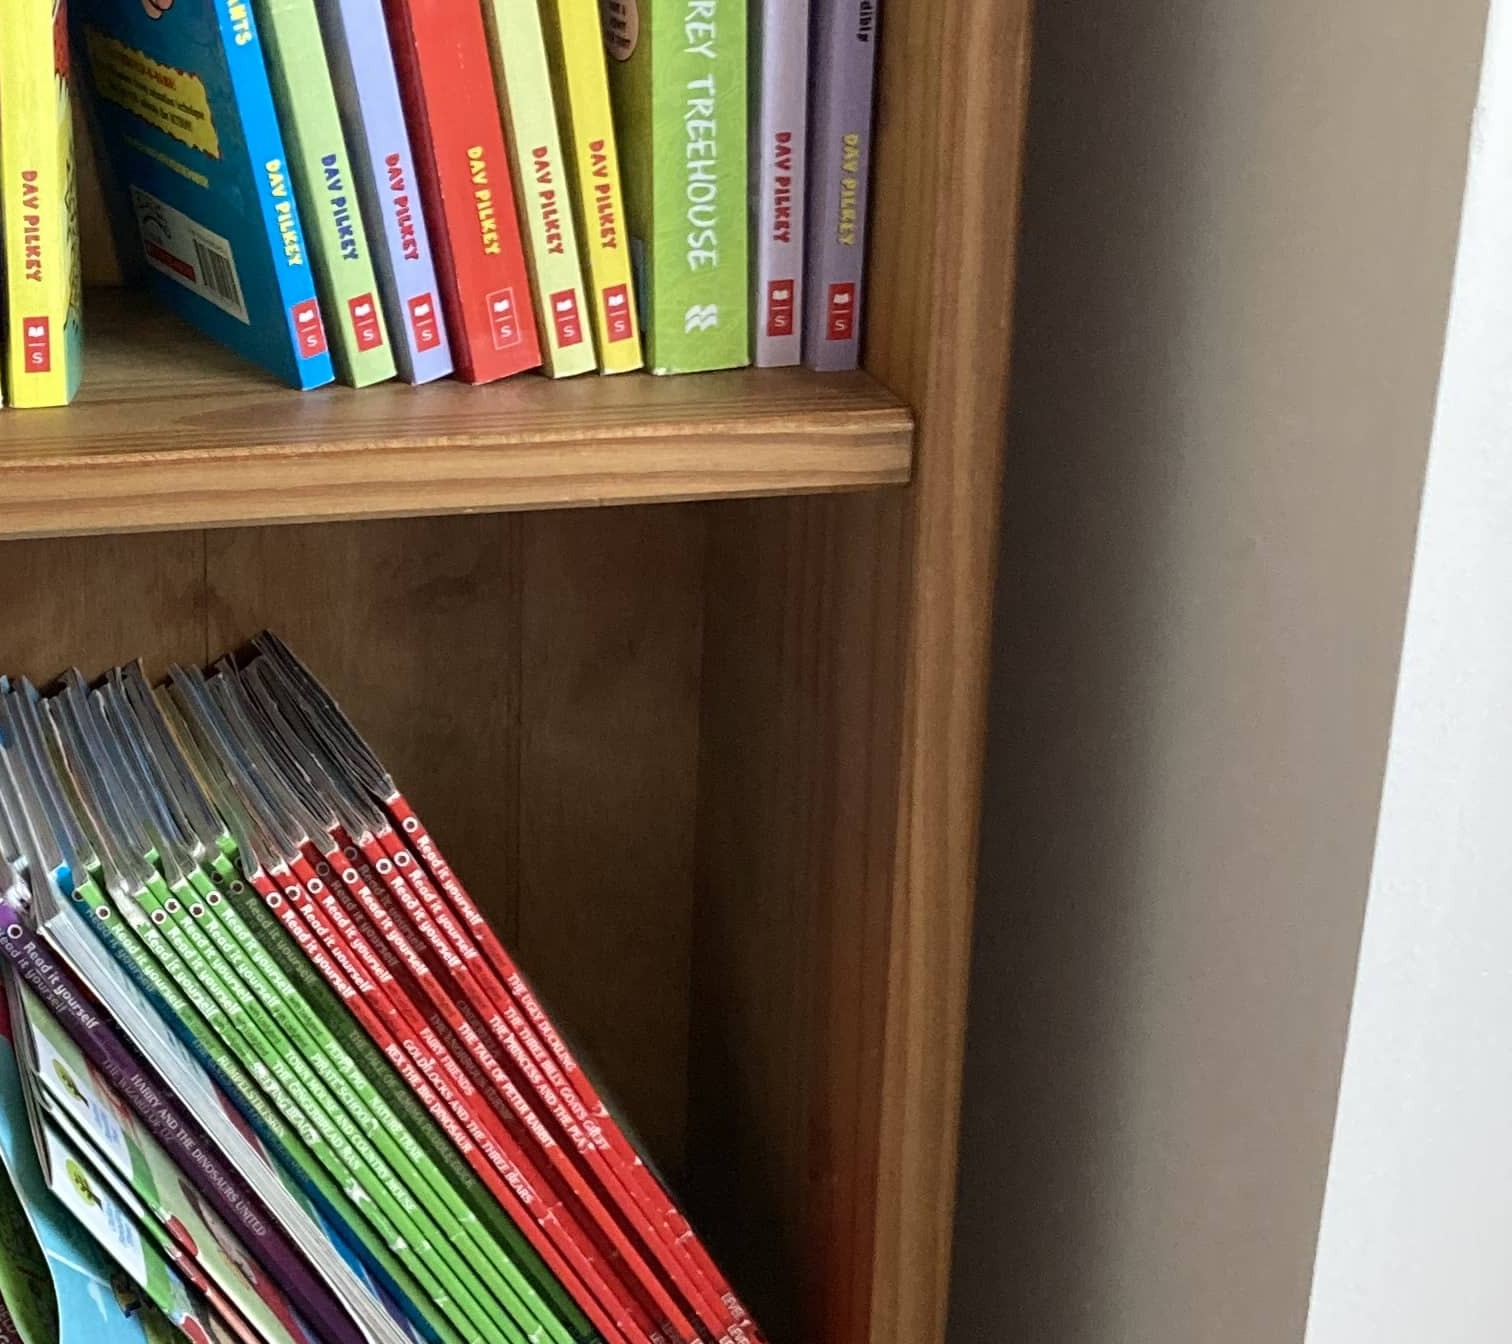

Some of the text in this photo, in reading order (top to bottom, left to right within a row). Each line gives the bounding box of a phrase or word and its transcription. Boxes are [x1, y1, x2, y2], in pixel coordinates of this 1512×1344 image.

[22, 170, 43, 282] DAV PILKEY
[386, 153, 419, 261] DAV PILKEY
[686, 74, 717, 271] TREEHOUSE
[24, 942, 99, 1030] Read it yourself
[130, 1074, 161, 1109] HARRY
[159, 1107, 179, 1131] AND
[177, 1129, 197, 1153] THE
[193, 1147, 238, 1205] DINOSAURS
[235, 1200, 267, 1237] UNITED
